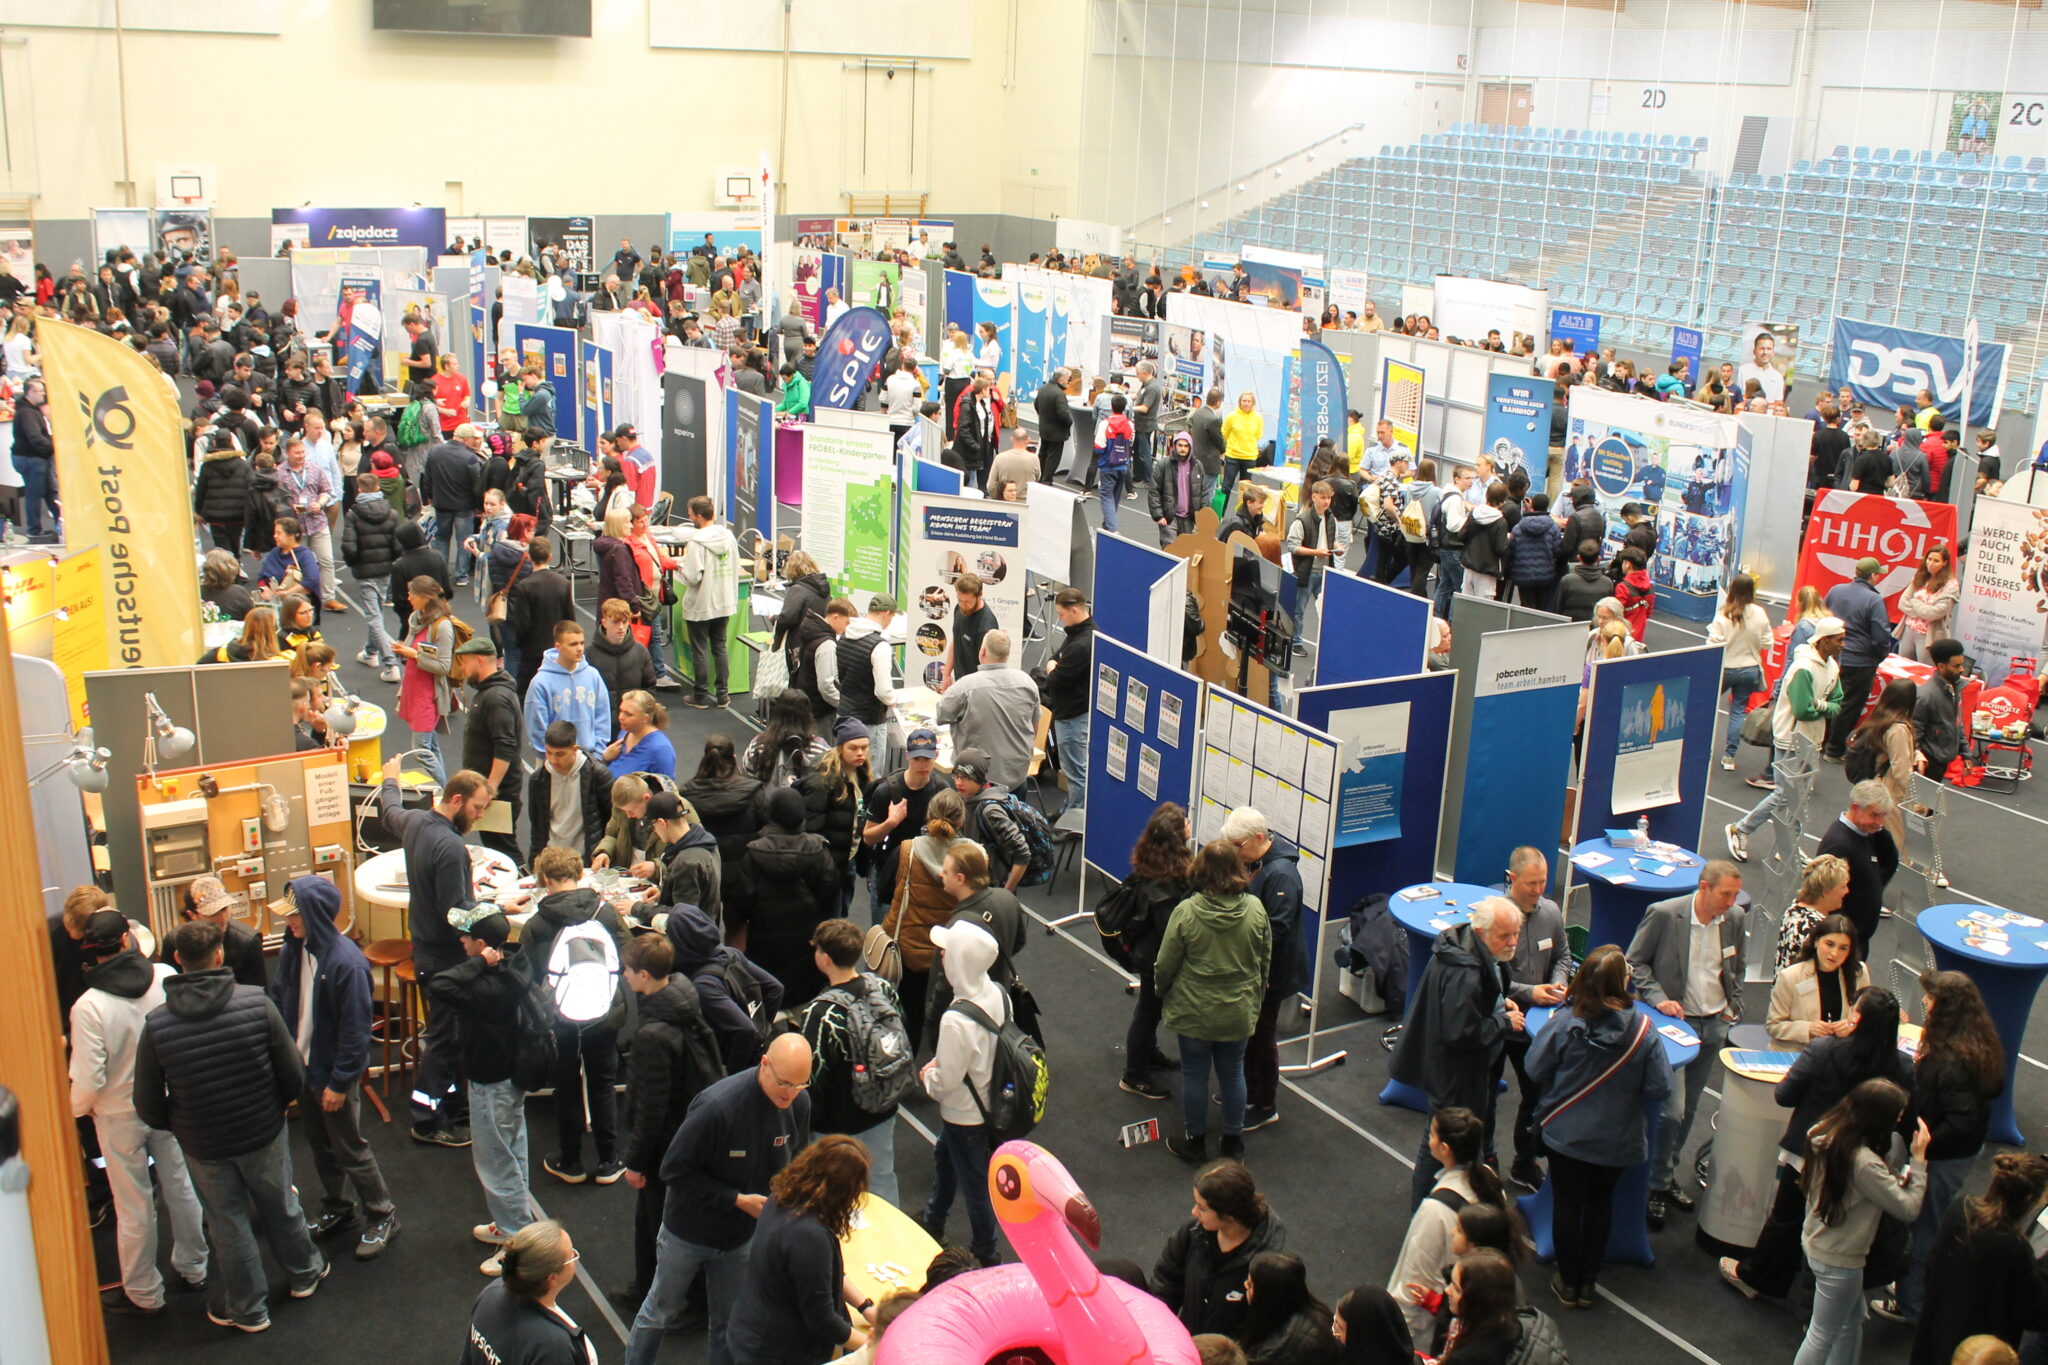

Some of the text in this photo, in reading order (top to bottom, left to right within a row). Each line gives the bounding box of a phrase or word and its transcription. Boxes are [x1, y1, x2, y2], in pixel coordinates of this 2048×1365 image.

[1642, 89, 1666, 109] 2D
[2009, 102, 2045, 127] 2C
[566, 240, 588, 249] DAS
[829, 329, 883, 407] SPIE
[1848, 339, 1980, 403] DSV
[1512, 388, 1530, 398] WIR
[1495, 396, 1544, 408] VERSTEHEN AUCH
[930, 514, 1013, 528] MENSCHEN BEGEISTERN
[930, 521, 954, 530] KOMM
[969, 525, 992, 533] TEAM!
[1982, 526, 2020, 543] WERDE
[1980, 538, 2011, 553] AUCH
[1978, 550, 2015, 567] DU EIN
[1977, 562, 1998, 575] TEIL
[1975, 573, 2021, 592] UNSERES
[1972, 584, 2012, 602] TEAMS!
[997, 597, 1020, 605] Gruppe
[1496, 667, 1538, 682] jobcenter
[1497, 674, 1567, 691] team.arbeit.hamburg
[314, 771, 338, 780] Modell
[318, 780, 336, 788] einer
[319, 787, 336, 795] Fuß-
[314, 795, 342, 805] gänger-
[317, 803, 341, 812] ampel-
[317, 809, 341, 819] anlage
